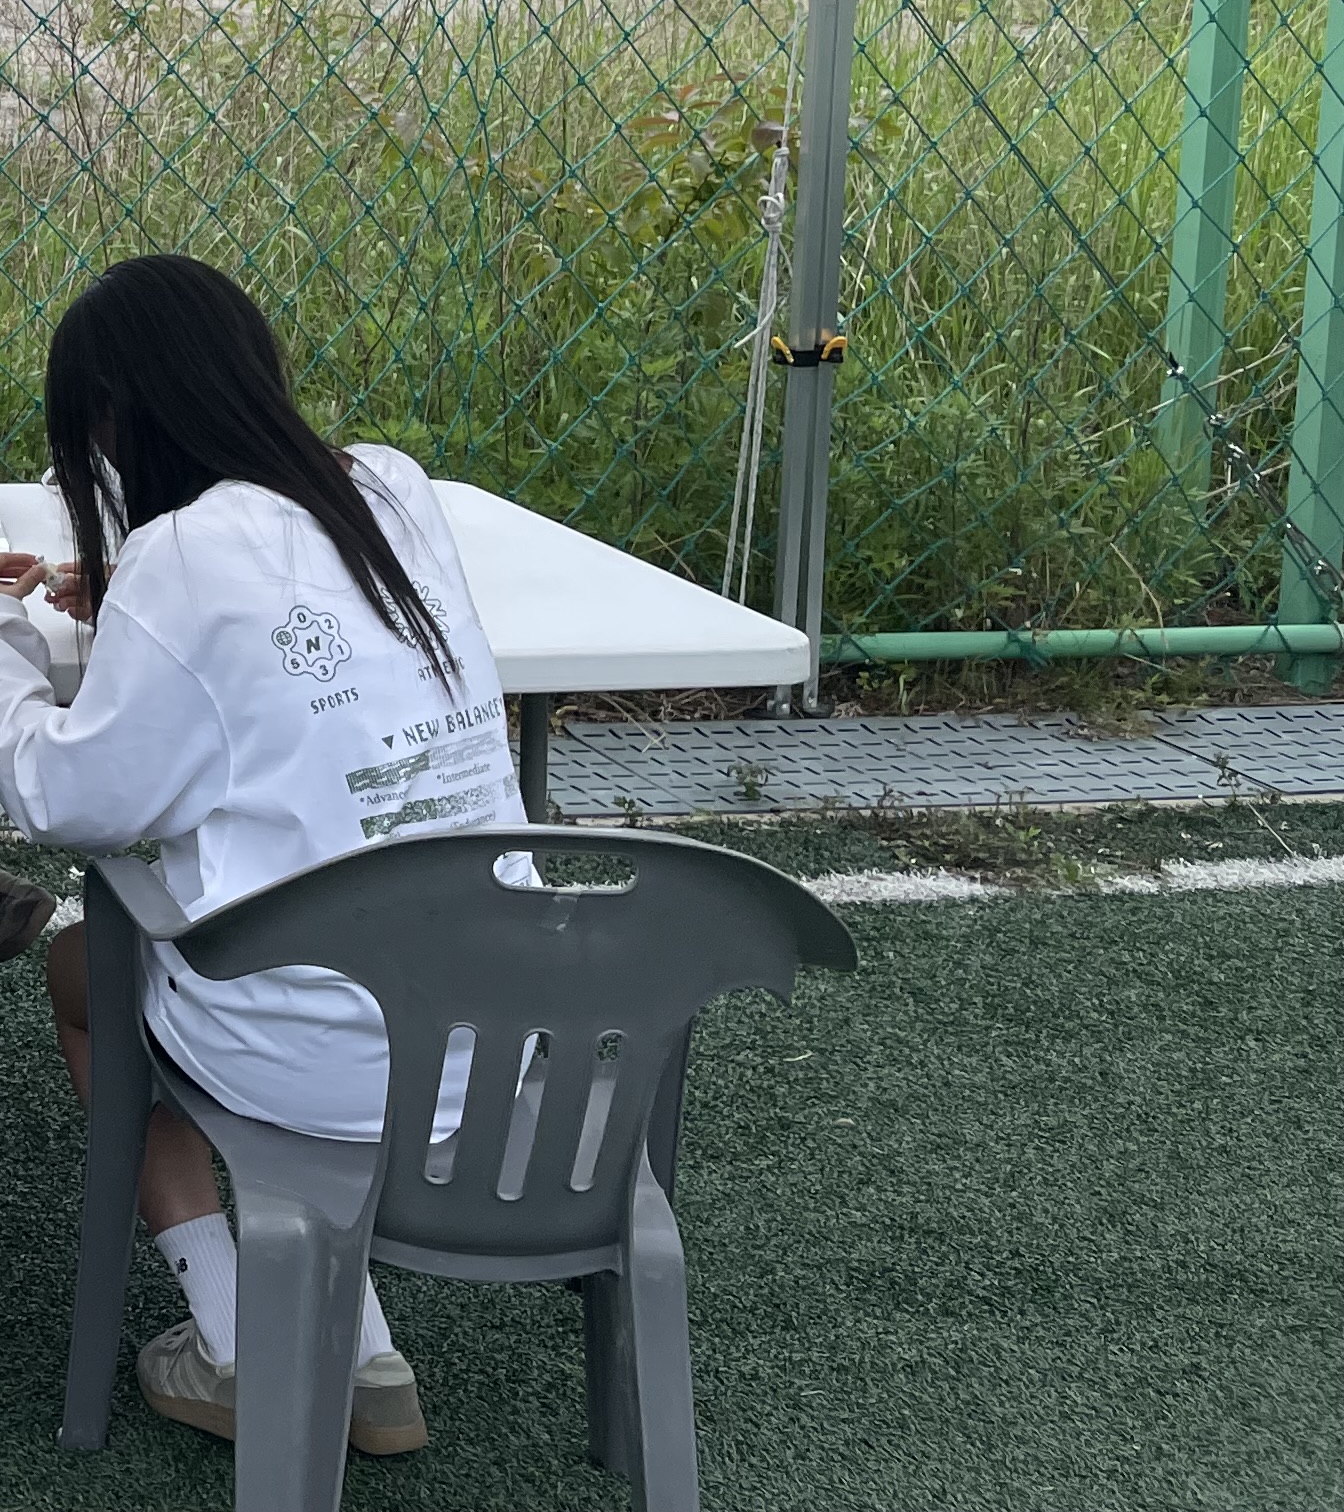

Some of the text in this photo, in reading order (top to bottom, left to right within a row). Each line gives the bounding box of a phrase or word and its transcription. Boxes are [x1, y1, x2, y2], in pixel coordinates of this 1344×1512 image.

[305, 635, 321, 654] N
[310, 687, 359, 715] SPORTS
[401, 718, 440, 746] NEW
